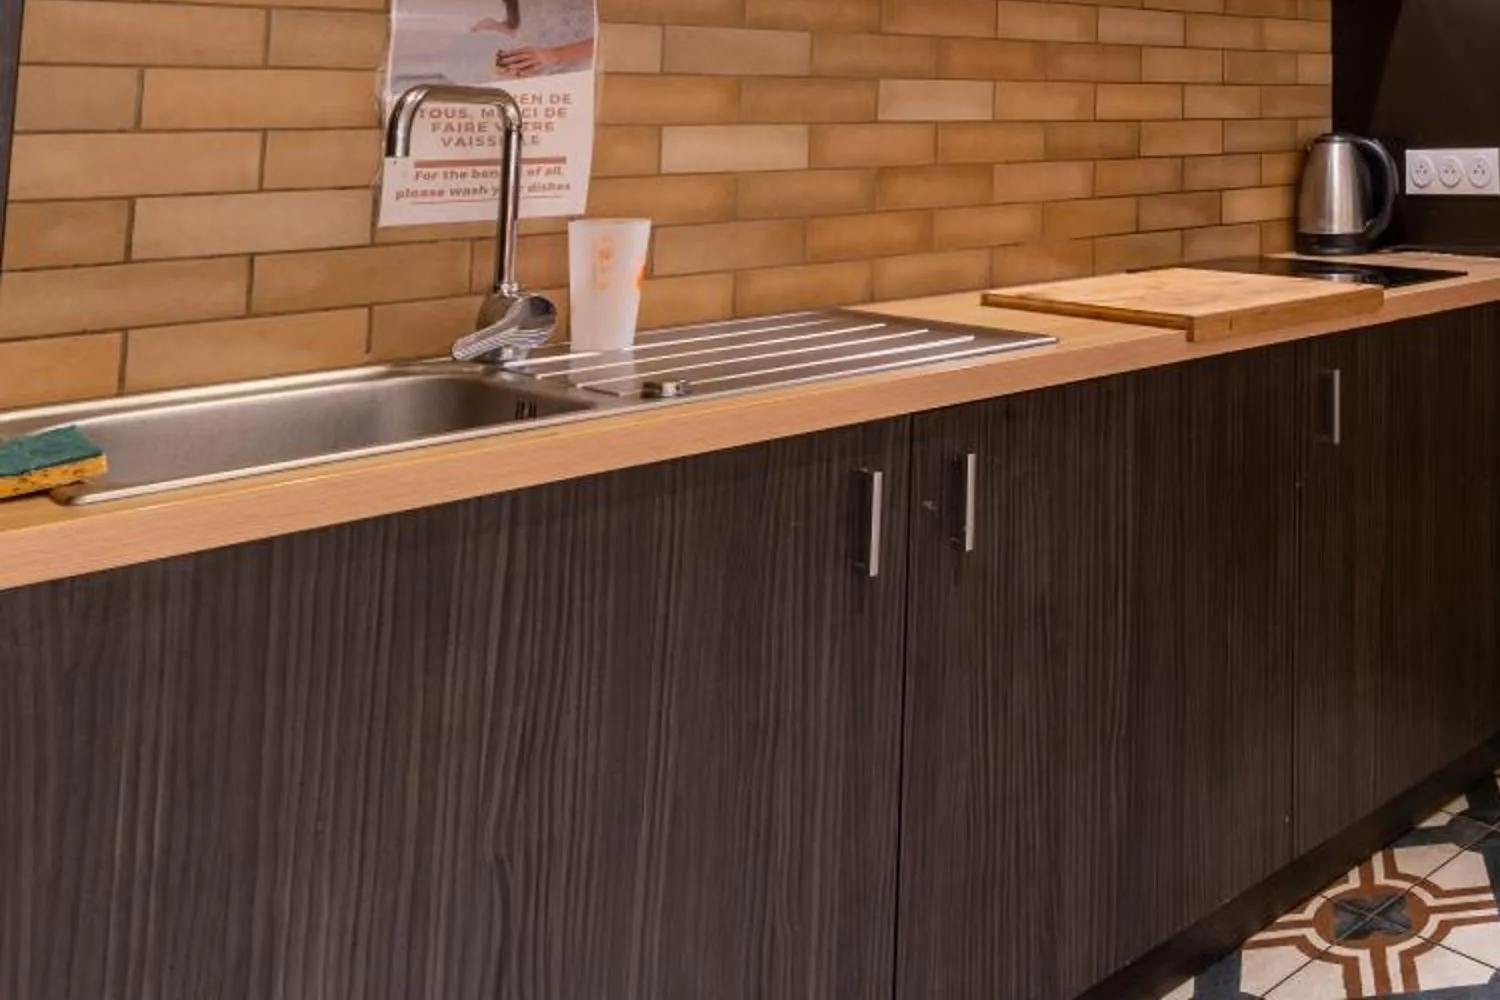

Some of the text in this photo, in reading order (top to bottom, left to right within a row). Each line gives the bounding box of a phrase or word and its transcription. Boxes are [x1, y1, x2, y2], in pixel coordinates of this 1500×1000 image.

[514, 92, 573, 105] IEN DE
[481, 107, 538, 118] MCI
[545, 107, 568, 118] DE
[431, 121, 555, 133] FAIRE VTRE
[441, 134, 540, 147] VAISSE
[415, 169, 438, 180] For
[443, 169, 469, 180] the
[396, 188, 445, 201] please
[449, 184, 488, 197] wash
[527, 181, 571, 193] dishes
